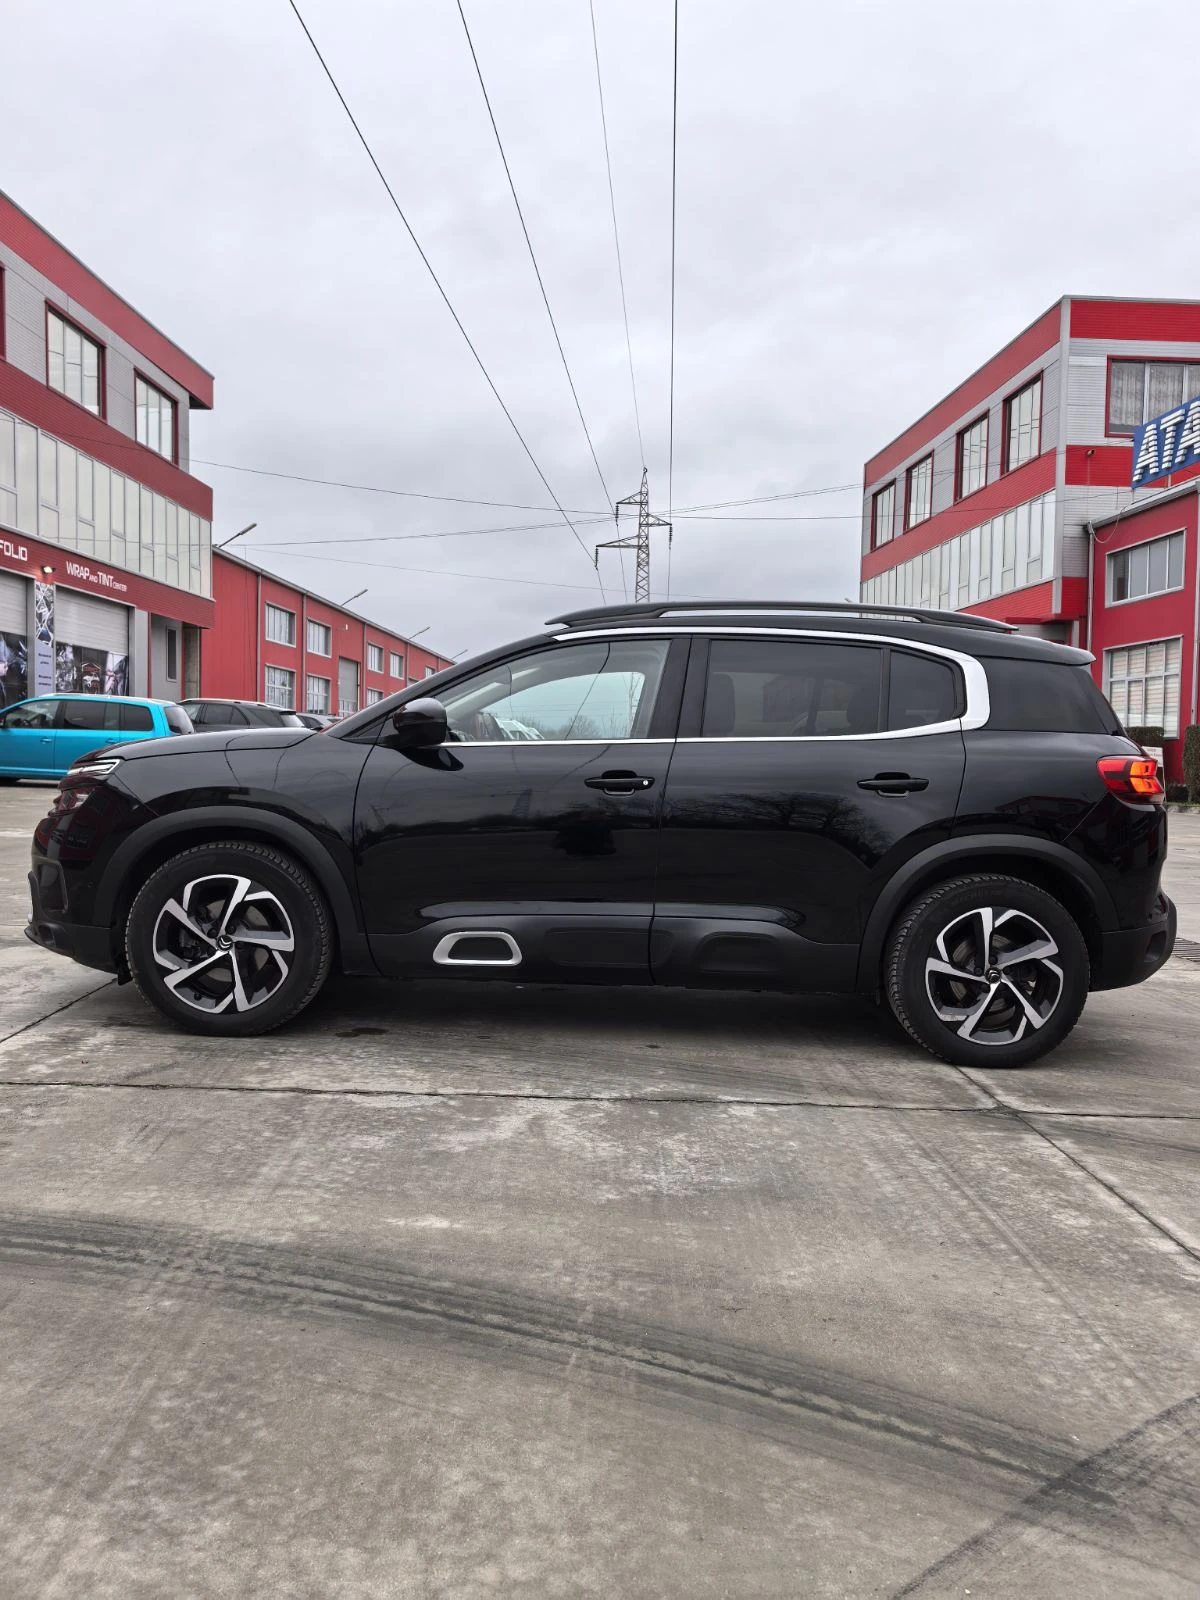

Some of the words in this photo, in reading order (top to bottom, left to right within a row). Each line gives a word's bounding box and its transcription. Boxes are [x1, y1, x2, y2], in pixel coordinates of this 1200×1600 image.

[66, 560, 90, 580] WRAP
[89, 574, 98, 584] AND
[97, 571, 114, 588] TINT
